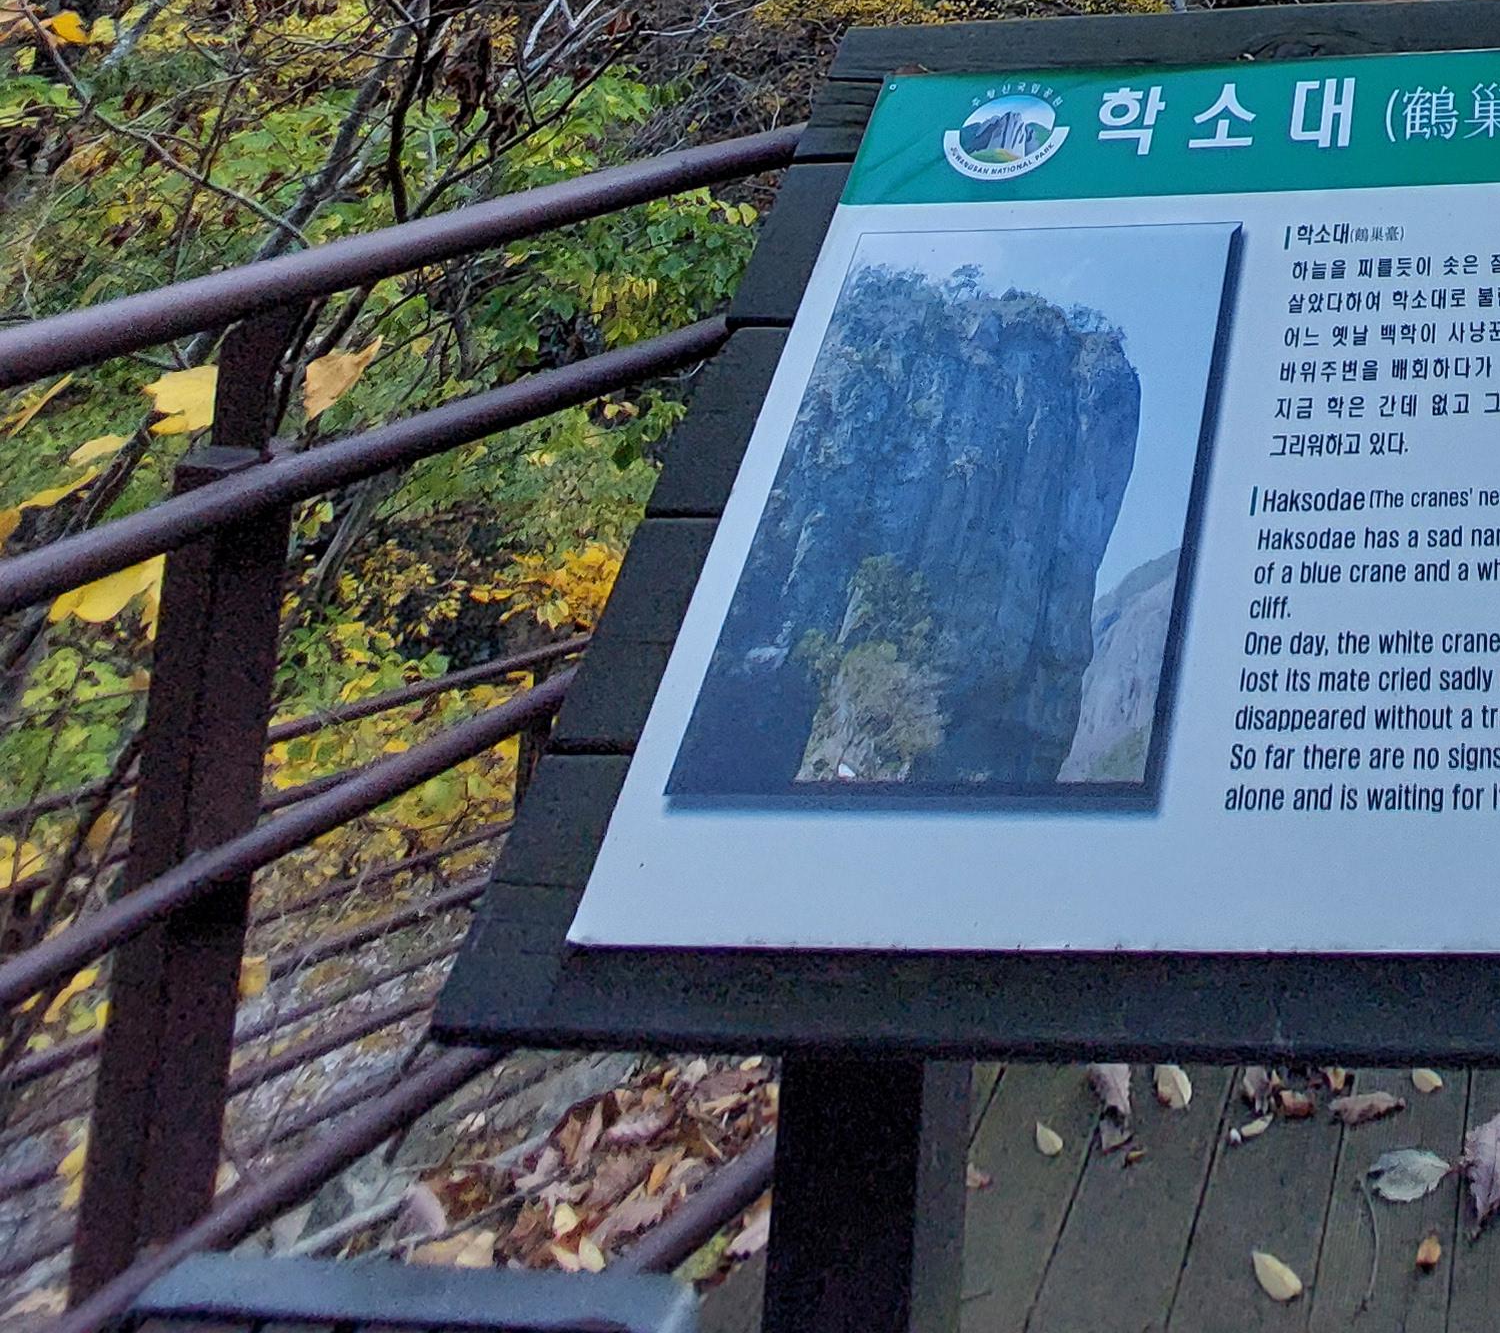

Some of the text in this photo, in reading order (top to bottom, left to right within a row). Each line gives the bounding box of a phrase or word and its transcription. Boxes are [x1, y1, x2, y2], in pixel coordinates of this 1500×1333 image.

[990, 159, 1033, 176] NATIONAL
[1292, 258, 1347, 282] 하늘을
[1356, 255, 1432, 279] 찌를듯이
[1442, 254, 1479, 276] 솟은
[1287, 289, 1381, 314] 살았다하여
[1392, 287, 1467, 312] 학소대로
[1283, 326, 1320, 349] 어느
[1331, 324, 1369, 348] 옛날
[1380, 322, 1437, 347] 백학이
[1279, 359, 1379, 385] 바위주변을
[1391, 355, 1493, 381] 배회하다가
[1273, 397, 1314, 421] 지금
[1327, 395, 1366, 420] 학은
[1378, 393, 1418, 418] 간데
[1431, 392, 1470, 417] 없고
[1269, 431, 1409, 458] 그리워하고 있다.
[1410, 487, 1474, 509] cranes'
[1257, 526, 1356, 551] Haksodae
[1363, 526, 1400, 550] has
[1407, 529, 1419, 550] a
[1426, 524, 1463, 549] sad
[1253, 561, 1276, 585] of
[1280, 564, 1293, 585] a
[1299, 560, 1342, 585] blue
[1349, 563, 1407, 584] crane
[1413, 558, 1451, 583] and
[1457, 561, 1470, 582] a
[1249, 595, 1292, 621] cliff.
[1244, 630, 1283, 656] One
[1289, 630, 1329, 658] day,
[1337, 630, 1371, 655] the
[1378, 629, 1434, 656] white
[1239, 667, 1280, 693] lost
[1284, 667, 1312, 693] its
[1317, 667, 1371, 693] mate
[1378, 666, 1432, 694] cried
[1438, 665, 1494, 694] sadly
[1234, 704, 1367, 733] disappeared
[1373, 703, 1454, 732] without
[1460, 707, 1473, 730] a
[1229, 743, 1257, 772] So
[1264, 743, 1296, 771] far
[1303, 743, 1361, 771] there
[1368, 746, 1405, 771] are
[1412, 746, 1440, 771] no
[1224, 783, 1285, 812] alone
[1292, 782, 1334, 813] and
[1339, 782, 1359, 812] is
[1366, 782, 1444, 814] waiting
[1451, 783, 1486, 812] for
